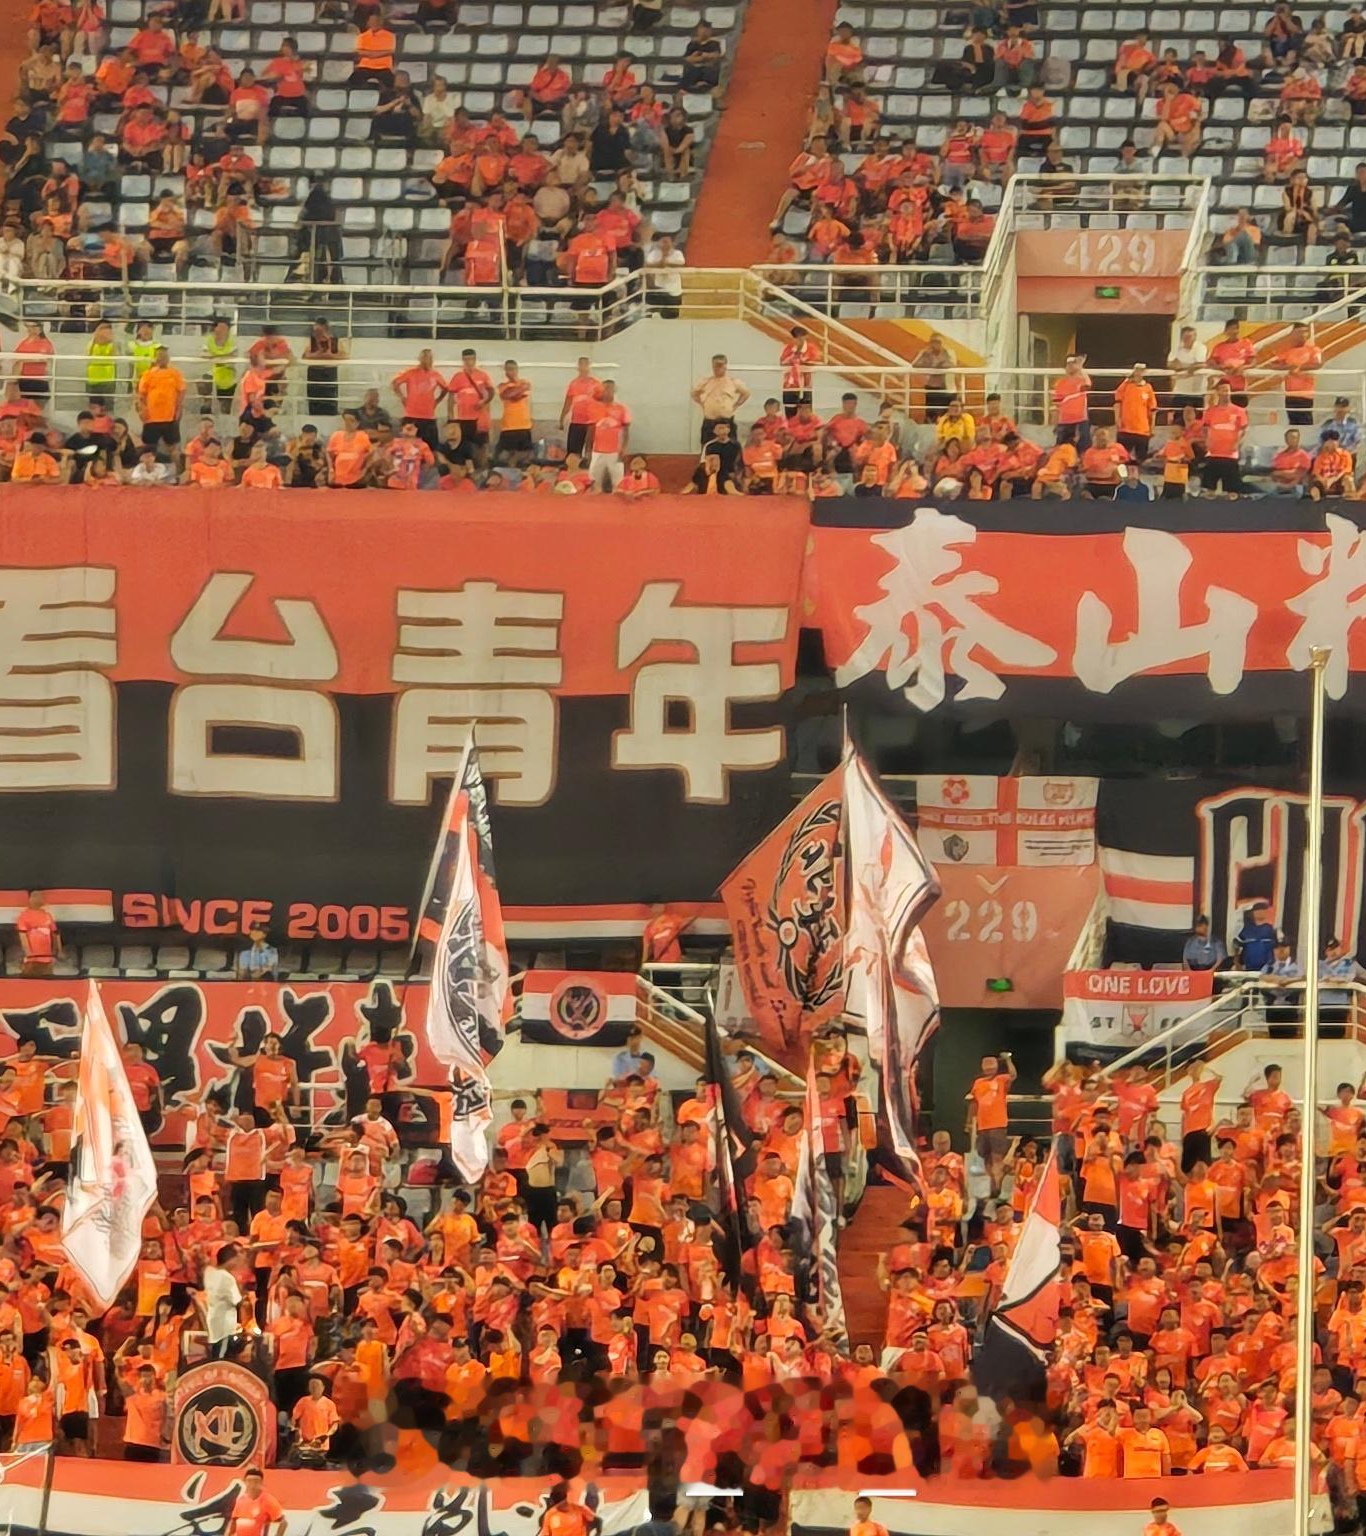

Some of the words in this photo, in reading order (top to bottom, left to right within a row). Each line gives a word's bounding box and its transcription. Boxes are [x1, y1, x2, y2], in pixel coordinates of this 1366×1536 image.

[1063, 232, 1156, 273] 429
[123, 893, 273, 935] SINCE
[288, 904, 410, 940] 2005
[944, 901, 1038, 942] 229
[1088, 975, 1131, 994] ONE
